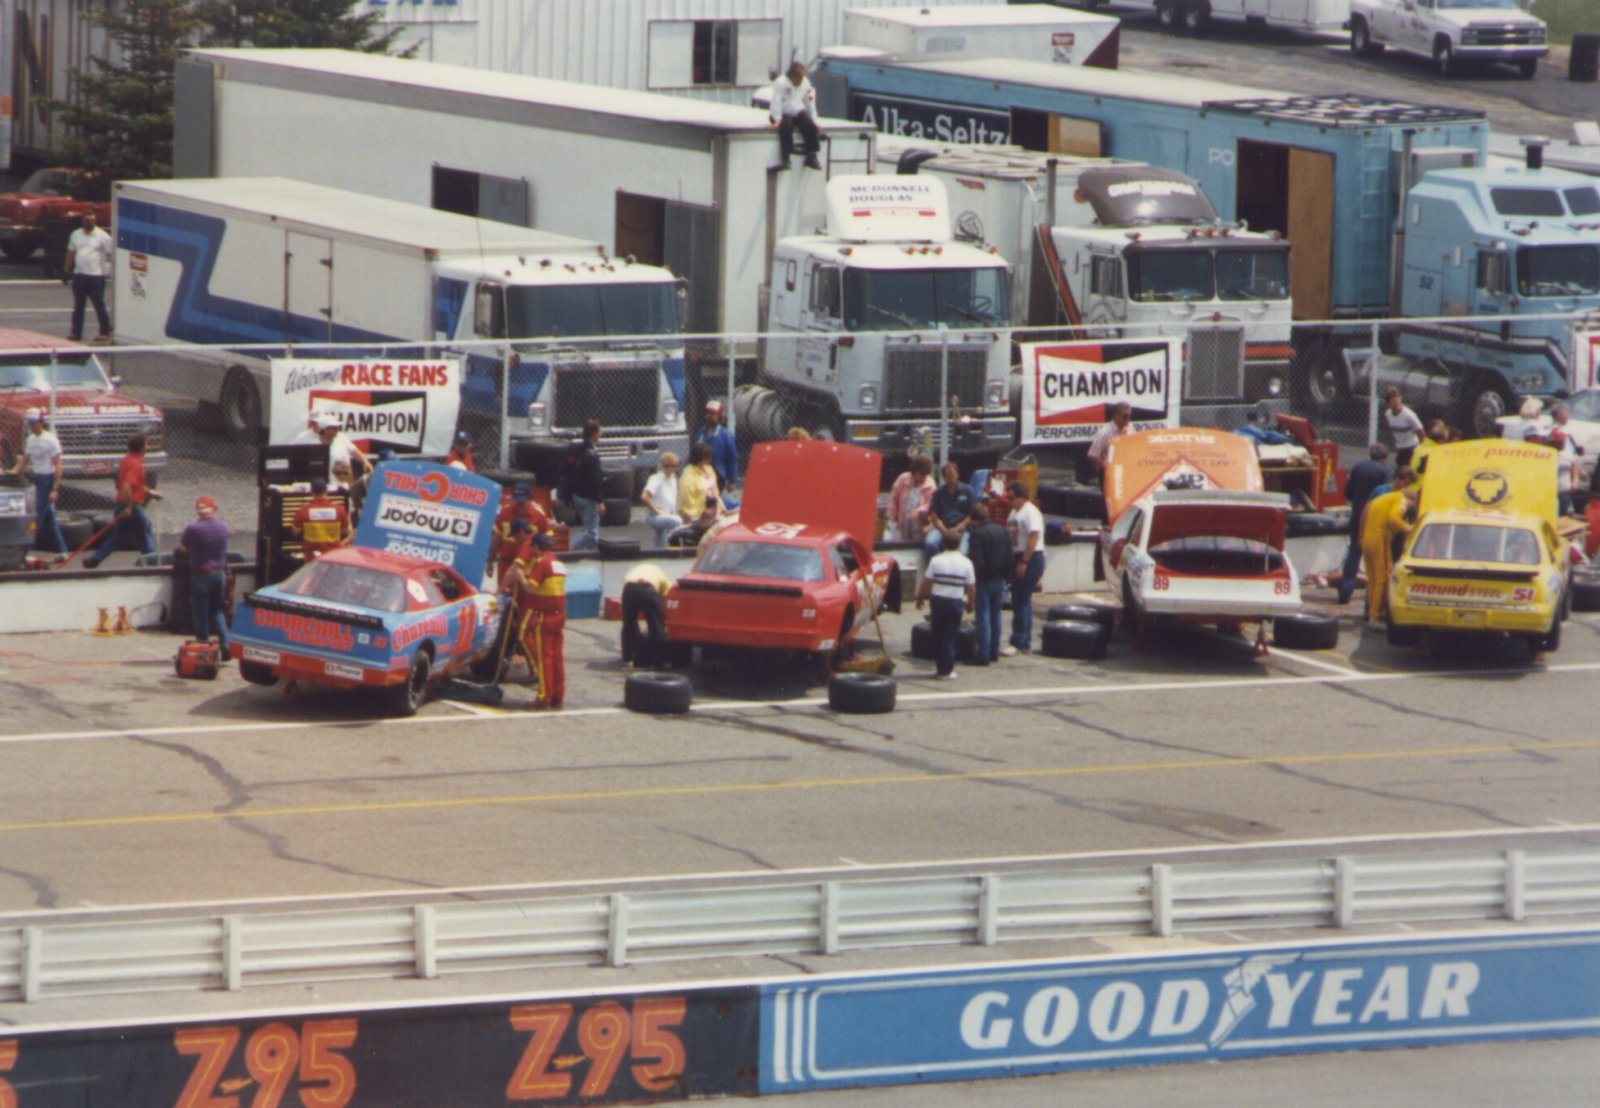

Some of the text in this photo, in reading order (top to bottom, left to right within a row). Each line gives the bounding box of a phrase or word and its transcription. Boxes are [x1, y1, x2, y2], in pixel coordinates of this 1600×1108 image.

[861, 104, 1011, 146] Alka-Seltz
[849, 194, 914, 203] DOUGLAS
[284, 364, 448, 395] Welcome RACE FANS
[1043, 368, 1162, 399] CHAMPION
[324, 411, 419, 433] HAMPION
[1034, 425, 1103, 439] PERFORMA
[1147, 433, 1216, 445] BUICK
[1484, 448, 1553, 459] mound
[1153, 577, 1170, 591] 89
[1274, 581, 1291, 595] 89
[1410, 582, 1503, 599] mound STEEL
[253, 607, 354, 640] CHURCHILL
[450, 601, 476, 656] 11
[392, 614, 448, 653] Churchill
